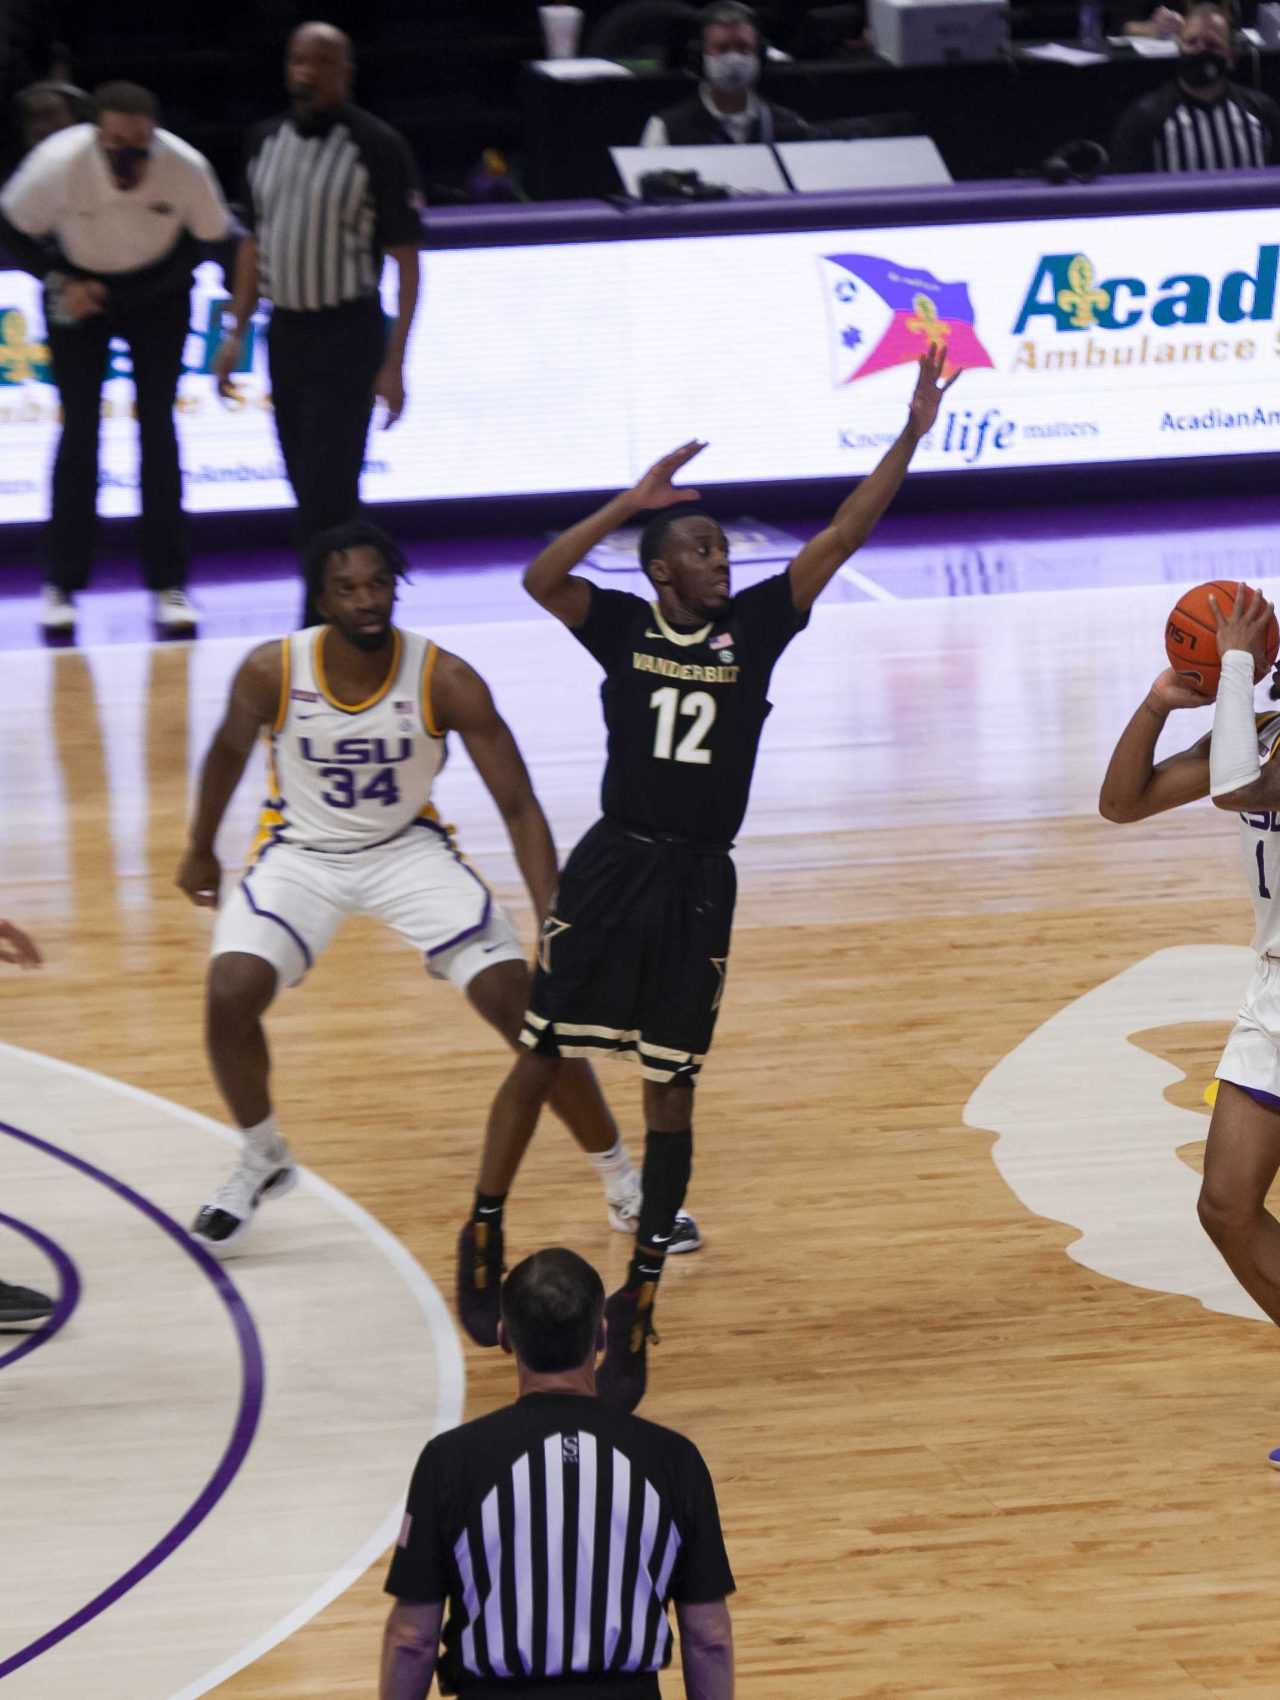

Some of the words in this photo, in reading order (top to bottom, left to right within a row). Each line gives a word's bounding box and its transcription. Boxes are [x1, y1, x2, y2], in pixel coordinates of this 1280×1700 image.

[1011, 333, 1257, 373] Ambulance
[942, 409, 1016, 464] life
[299, 736, 413, 764] LSU
[649, 687, 717, 765] 12
[318, 766, 401, 809] 34
[1256, 839, 1272, 899] 1
